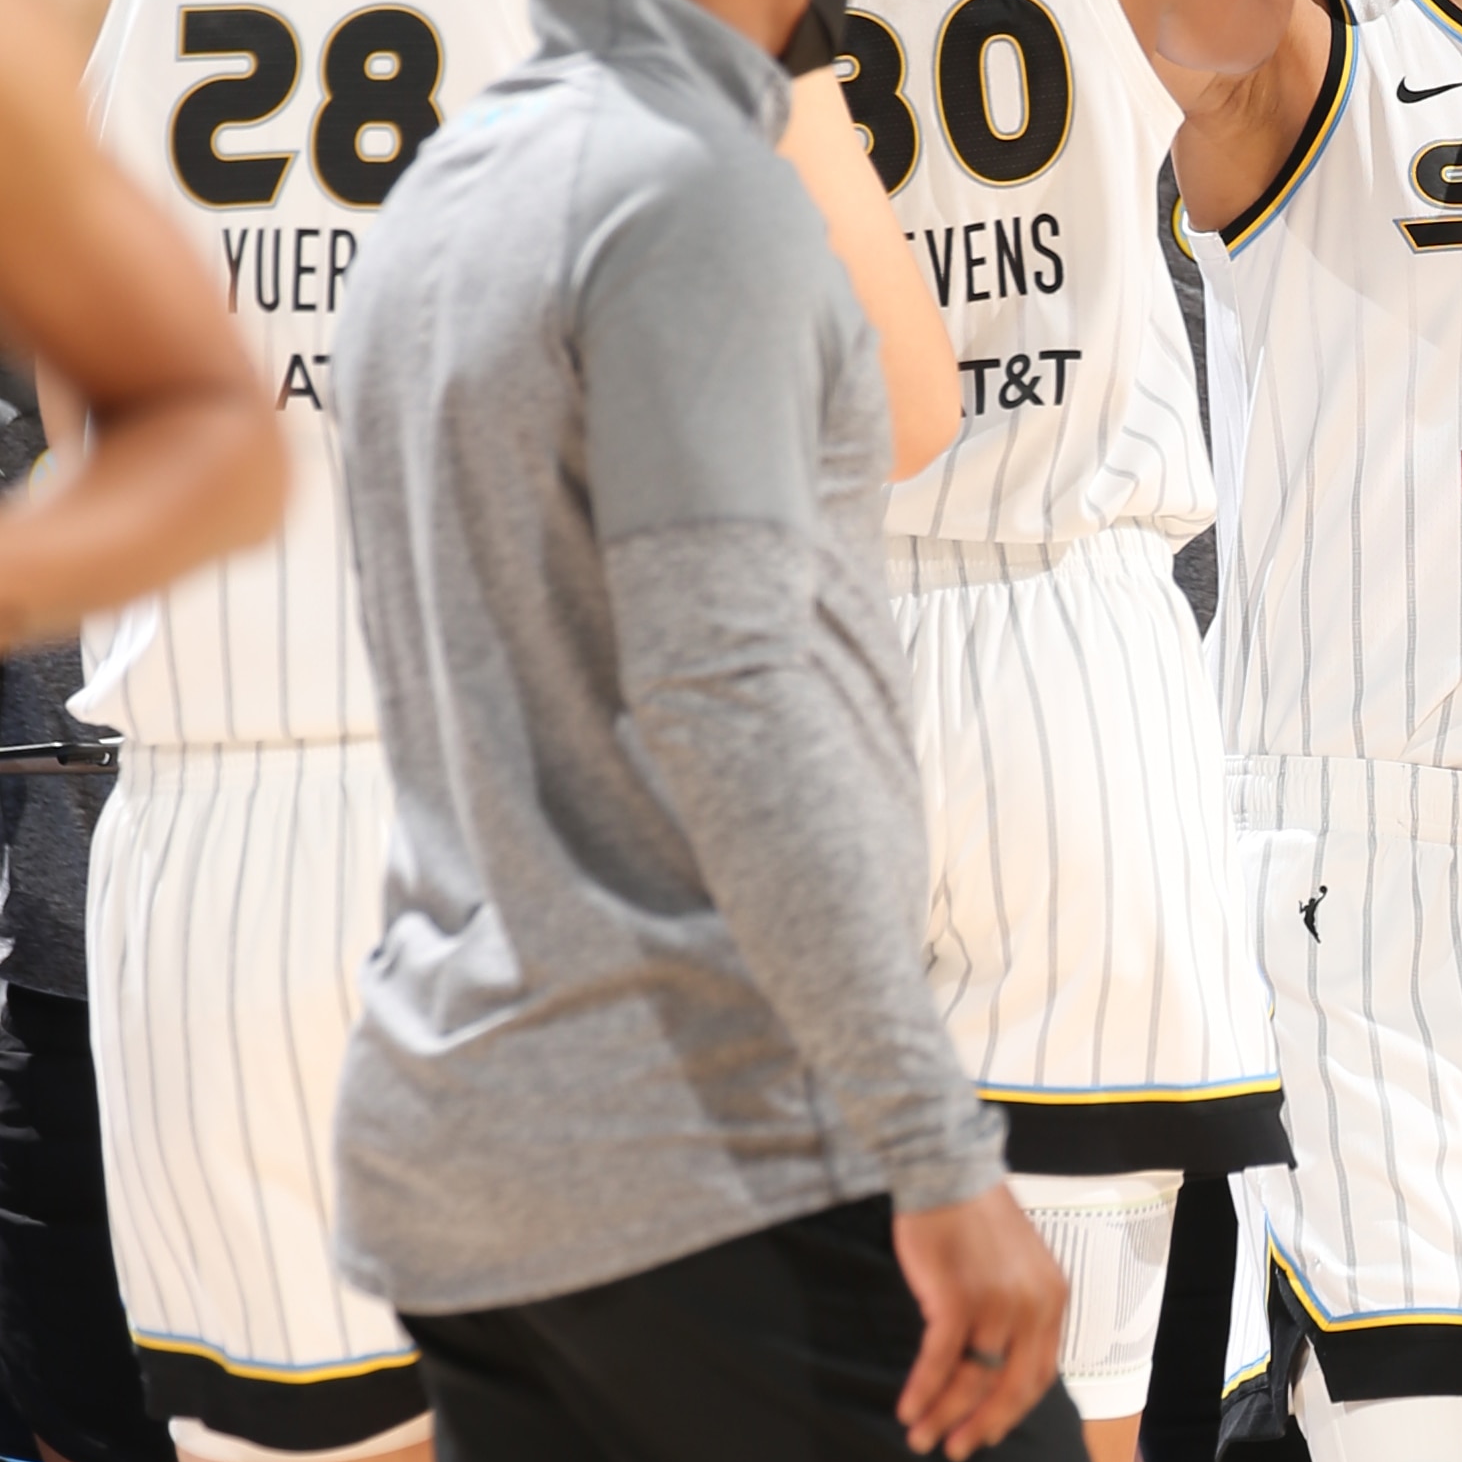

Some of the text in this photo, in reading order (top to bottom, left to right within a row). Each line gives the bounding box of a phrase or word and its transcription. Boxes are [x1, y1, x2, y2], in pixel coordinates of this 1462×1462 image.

[168, 3, 446, 210] 28
[905, 212, 1064, 308] VENS
[958, 349, 1082, 417] T&T
